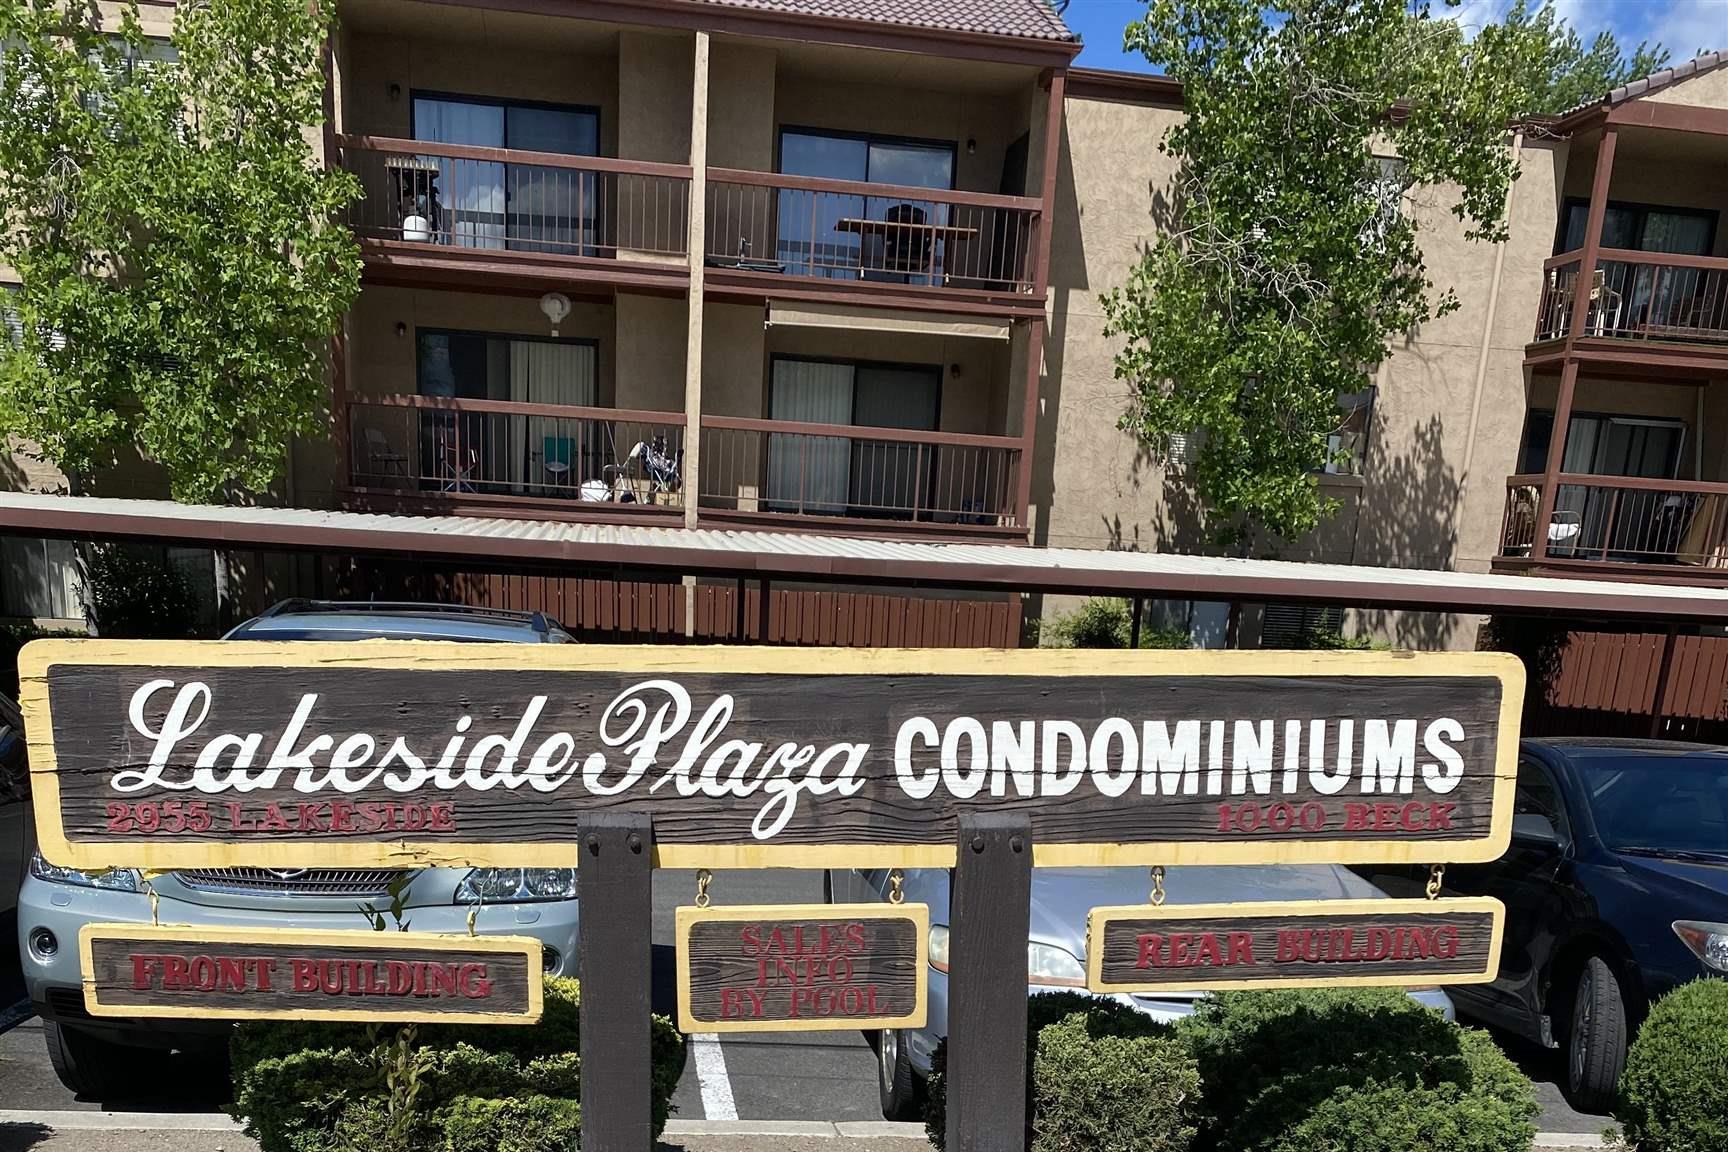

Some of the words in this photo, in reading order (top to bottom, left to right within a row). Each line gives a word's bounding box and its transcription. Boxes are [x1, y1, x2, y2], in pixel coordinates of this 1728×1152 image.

[111, 679, 579, 793] Lakeside
[582, 679, 871, 840] Plaza
[894, 716, 1466, 800] CONDOMINIUMS
[105, 800, 212, 832] 2955
[228, 801, 457, 833] LAKESIDE
[1217, 800, 1328, 833] 1000
[1343, 801, 1456, 832] BECK
[740, 922, 867, 956] SALES
[1134, 929, 1255, 971] REAR
[1275, 924, 1460, 965] BUILDING
[130, 953, 276, 994] FRONT
[292, 957, 495, 999] BUILDING
[756, 955, 854, 987] INFO
[720, 987, 768, 1019] BY
[788, 983, 892, 1018] POOL
